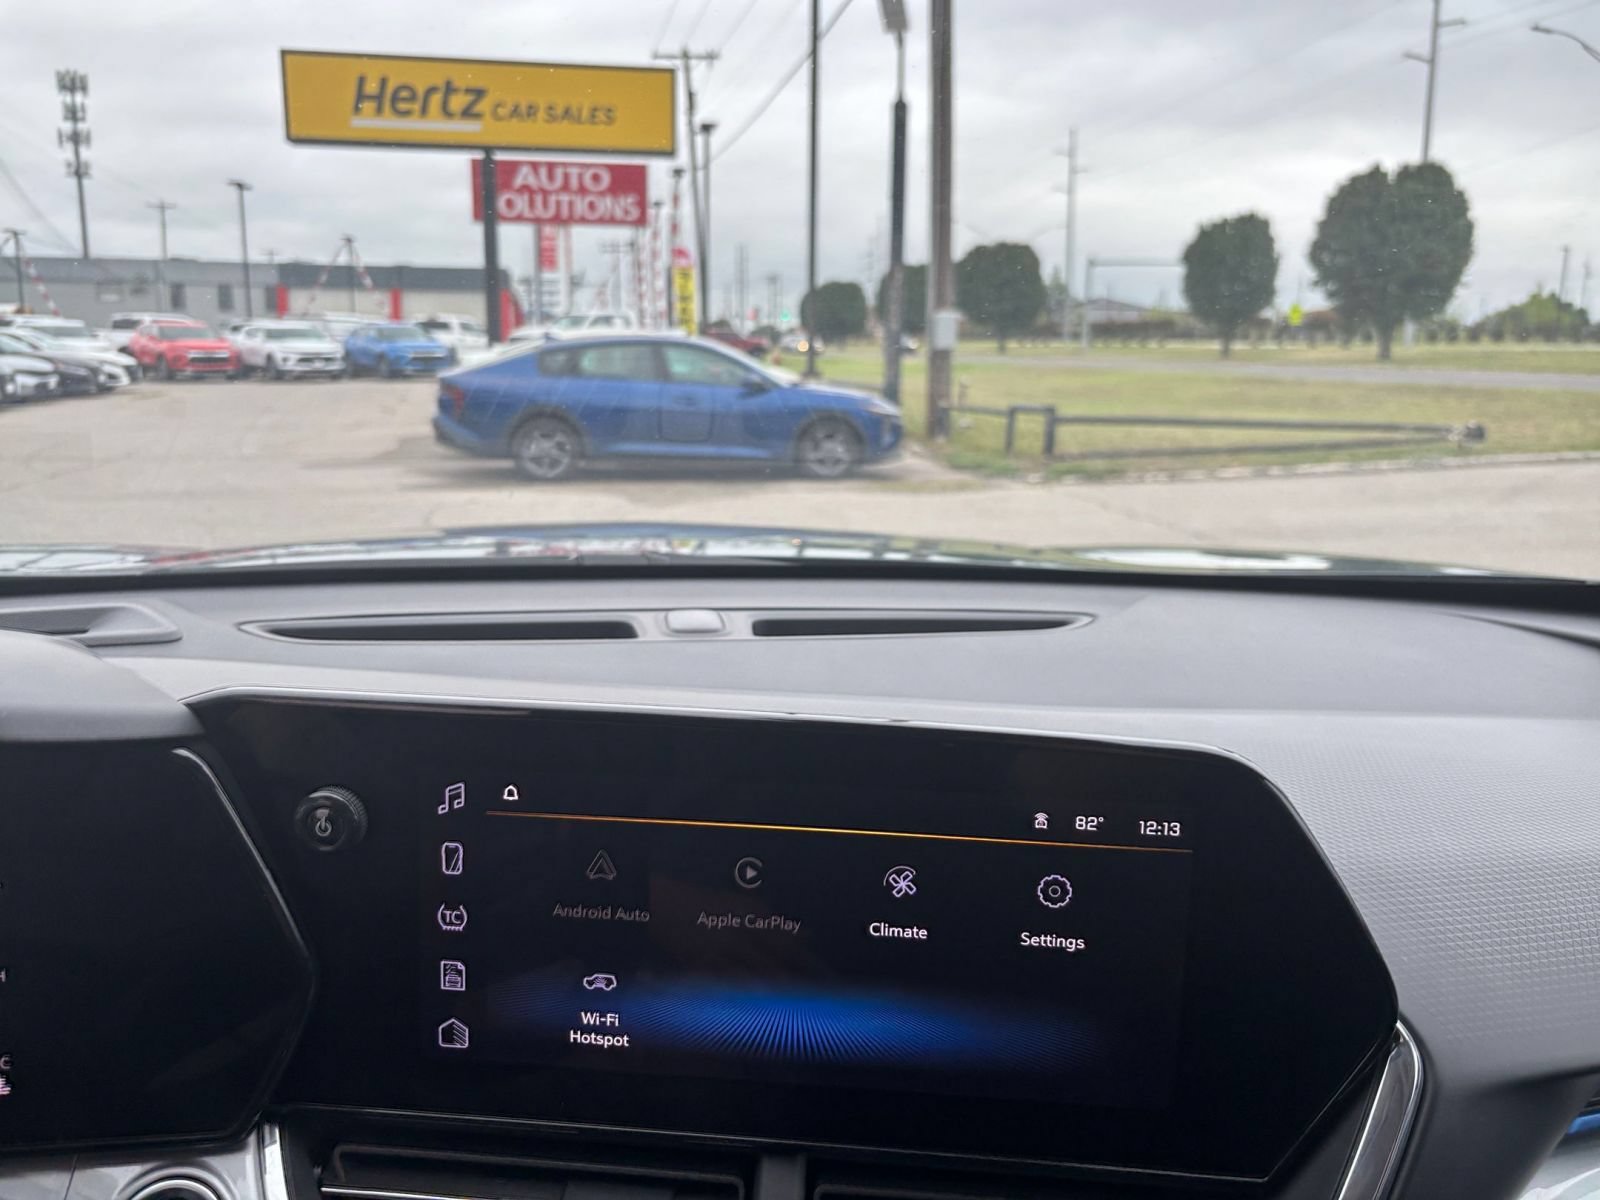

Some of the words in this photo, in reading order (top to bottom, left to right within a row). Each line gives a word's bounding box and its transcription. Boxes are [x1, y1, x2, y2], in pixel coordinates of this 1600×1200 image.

[352, 74, 487, 120] Hertz
[491, 101, 538, 124] CAR
[547, 104, 616, 126] SALES
[512, 163, 611, 193] AUTO
[497, 191, 641, 222] OLUTIONS
[1138, 820, 1182, 837] 12:13
[442, 910, 462, 924] TC
[553, 903, 612, 920] Android
[615, 905, 650, 922] Auto
[697, 911, 742, 930] Apple
[745, 914, 802, 934] CarPlay
[869, 922, 929, 940] Climate
[1020, 932, 1086, 952] Settings
[580, 1011, 620, 1028] Wi-Fi
[569, 1030, 630, 1049] Hotspot
